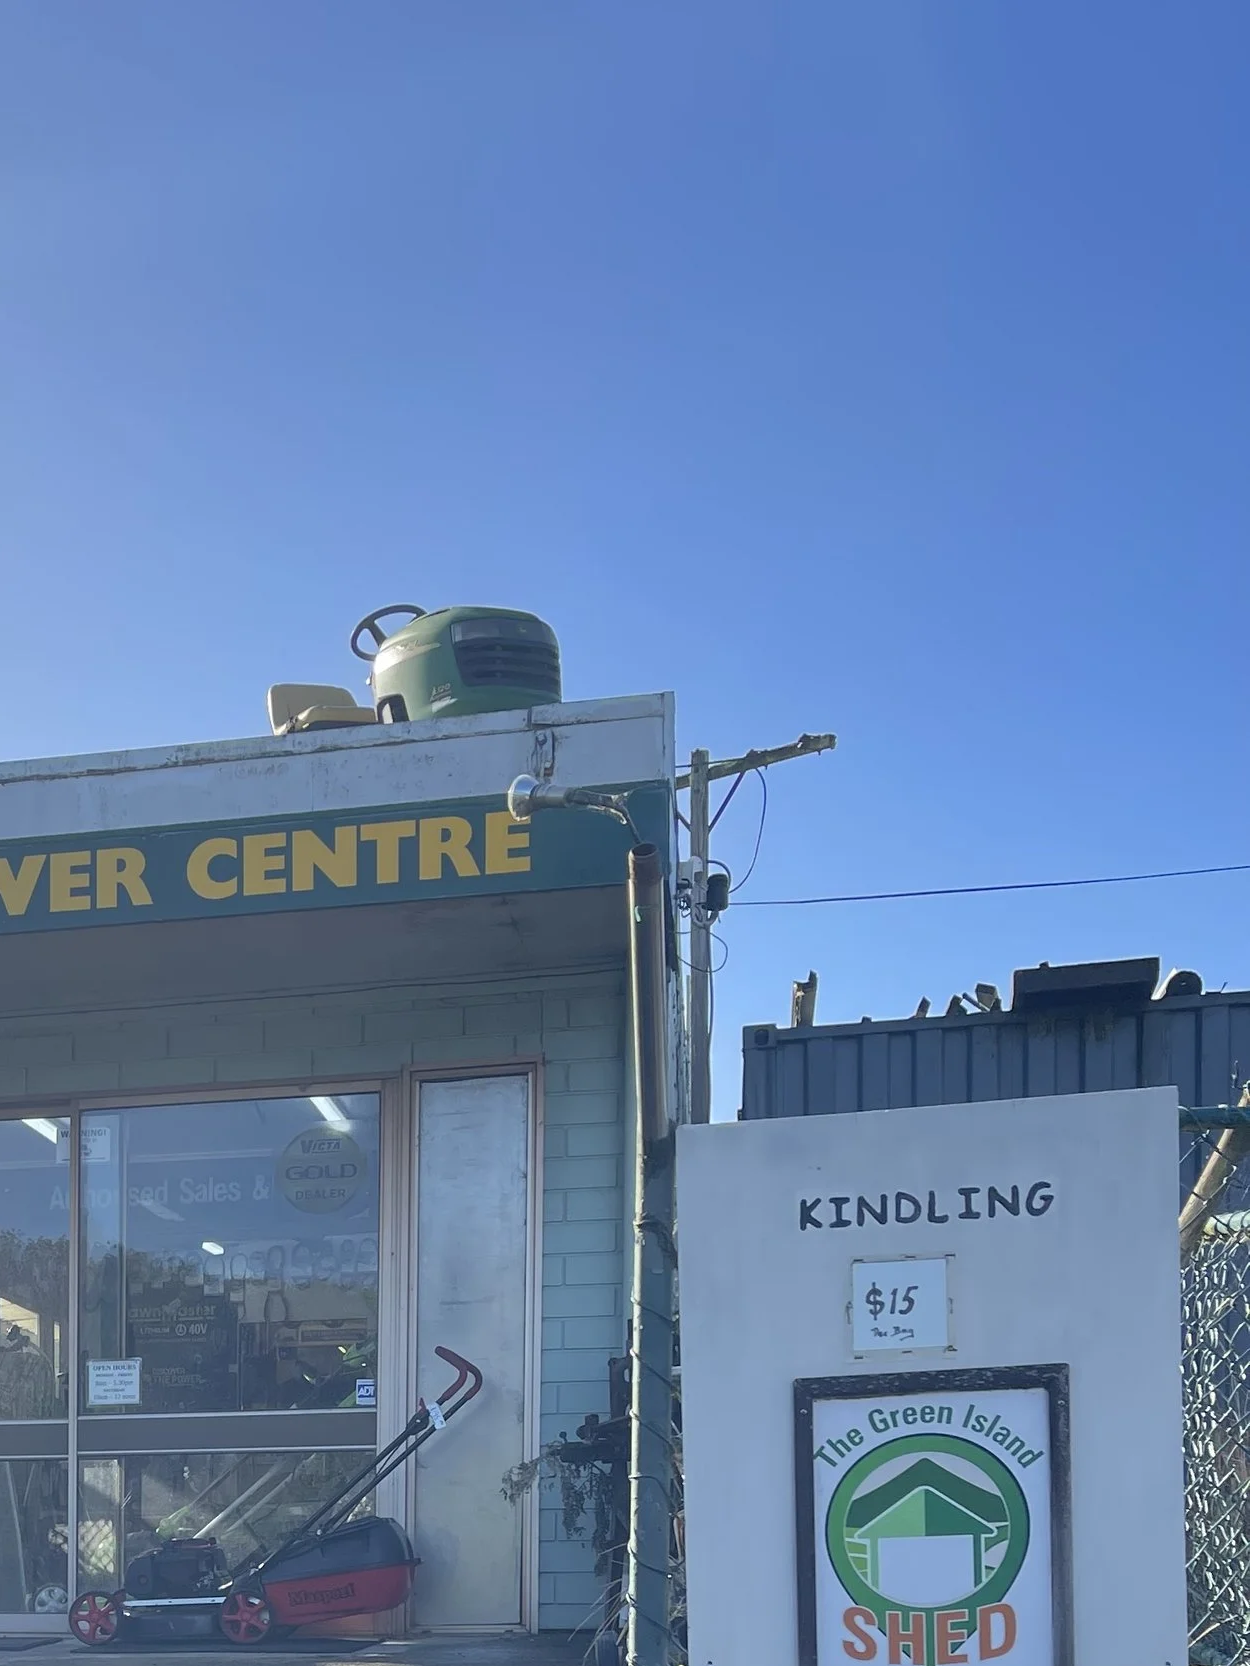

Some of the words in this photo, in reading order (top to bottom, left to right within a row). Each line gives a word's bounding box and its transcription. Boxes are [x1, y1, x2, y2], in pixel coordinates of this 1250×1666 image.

[186, 812, 532, 901] CENTRE
[300, 1138, 342, 1154] VICTA
[180, 1176, 241, 1205] Sales
[253, 1174, 270, 1200] &
[285, 1163, 358, 1181] GOLD
[295, 1188, 346, 1201] DEALER
[799, 1180, 1056, 1231] KINDLING
[865, 1281, 919, 1321] $15
[357, 1385, 374, 1397] ADT
[812, 1426, 865, 1471] The
[867, 1402, 954, 1436] Green
[961, 1403, 1045, 1470] Island
[841, 1601, 1019, 1666] SHED
